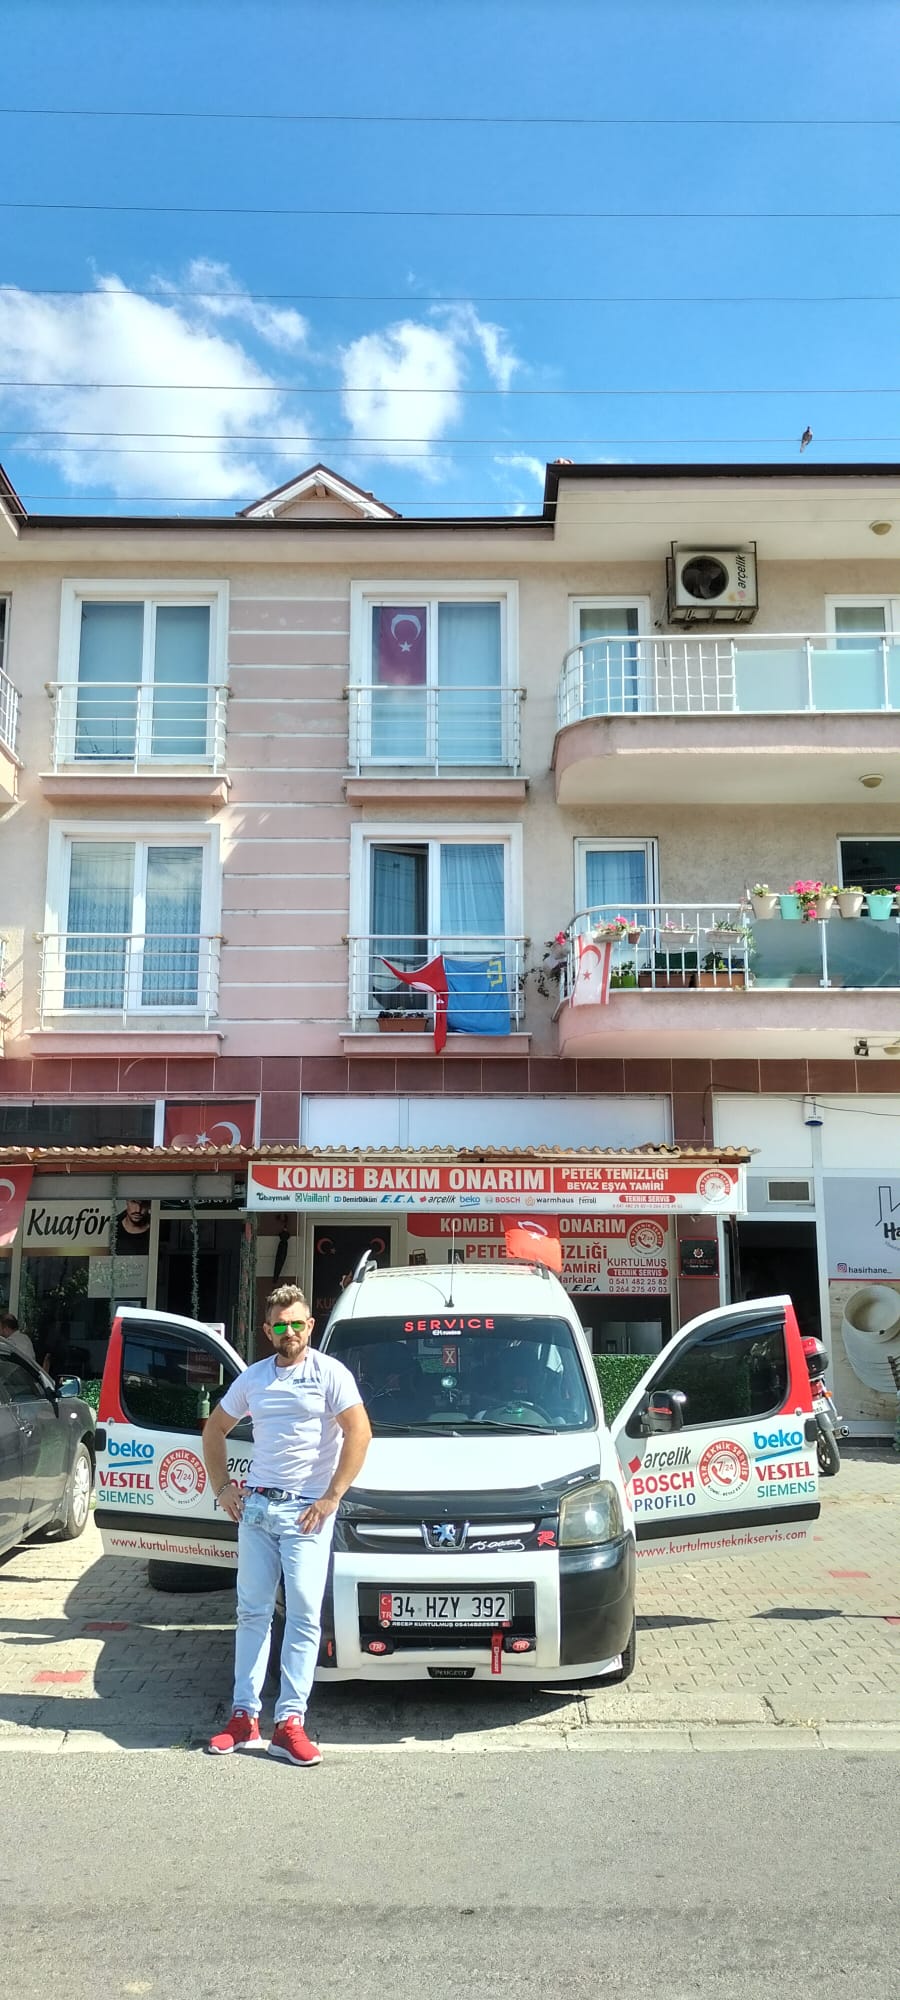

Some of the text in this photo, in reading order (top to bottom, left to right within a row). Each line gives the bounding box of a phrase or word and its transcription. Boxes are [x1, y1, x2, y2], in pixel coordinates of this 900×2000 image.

[735, 553, 748, 589] arçelik
[363, 1168, 440, 1190] BAKIM
[449, 1168, 545, 1190] ONARIM
[561, 1168, 602, 1180] PETEK
[567, 1180, 664, 1192] BEYAZ EŞYA TAMİRİ
[302, 1193, 330, 1203] Vaillant
[342, 1195, 378, 1203] DemirDöküm
[428, 1195, 456, 1204] arçelik
[460, 1195, 480, 1203] beko
[27, 1208, 111, 1240] Kuaför
[560, 1218, 626, 1233] ONARIM
[465, 1244, 507, 1258] PETE
[561, 1261, 601, 1273] AMİRİ
[607, 1258, 667, 1269] KURTULMUŞ
[560, 1275, 596, 1284] arkalar
[403, 1318, 495, 1332] SERVICE
[753, 1429, 803, 1450] beko
[107, 1438, 154, 1458] beko
[643, 1446, 691, 1471] arçelik
[175, 1468, 192, 1482] 7/24
[754, 1462, 815, 1482] VESTEL
[98, 1471, 154, 1490] VESTEL
[632, 1471, 695, 1496] BOSCH
[757, 1480, 816, 1498] SIEMENS
[98, 1490, 154, 1506] SIEMENS
[635, 1529, 807, 1558] www.kurtulmusteknikservis.com
[393, 1596, 506, 1618] 34 HZY 392
[380, 1611, 392, 1619] TR
[371, 1642, 383, 1651] TR
[516, 1641, 527, 1650] TR
